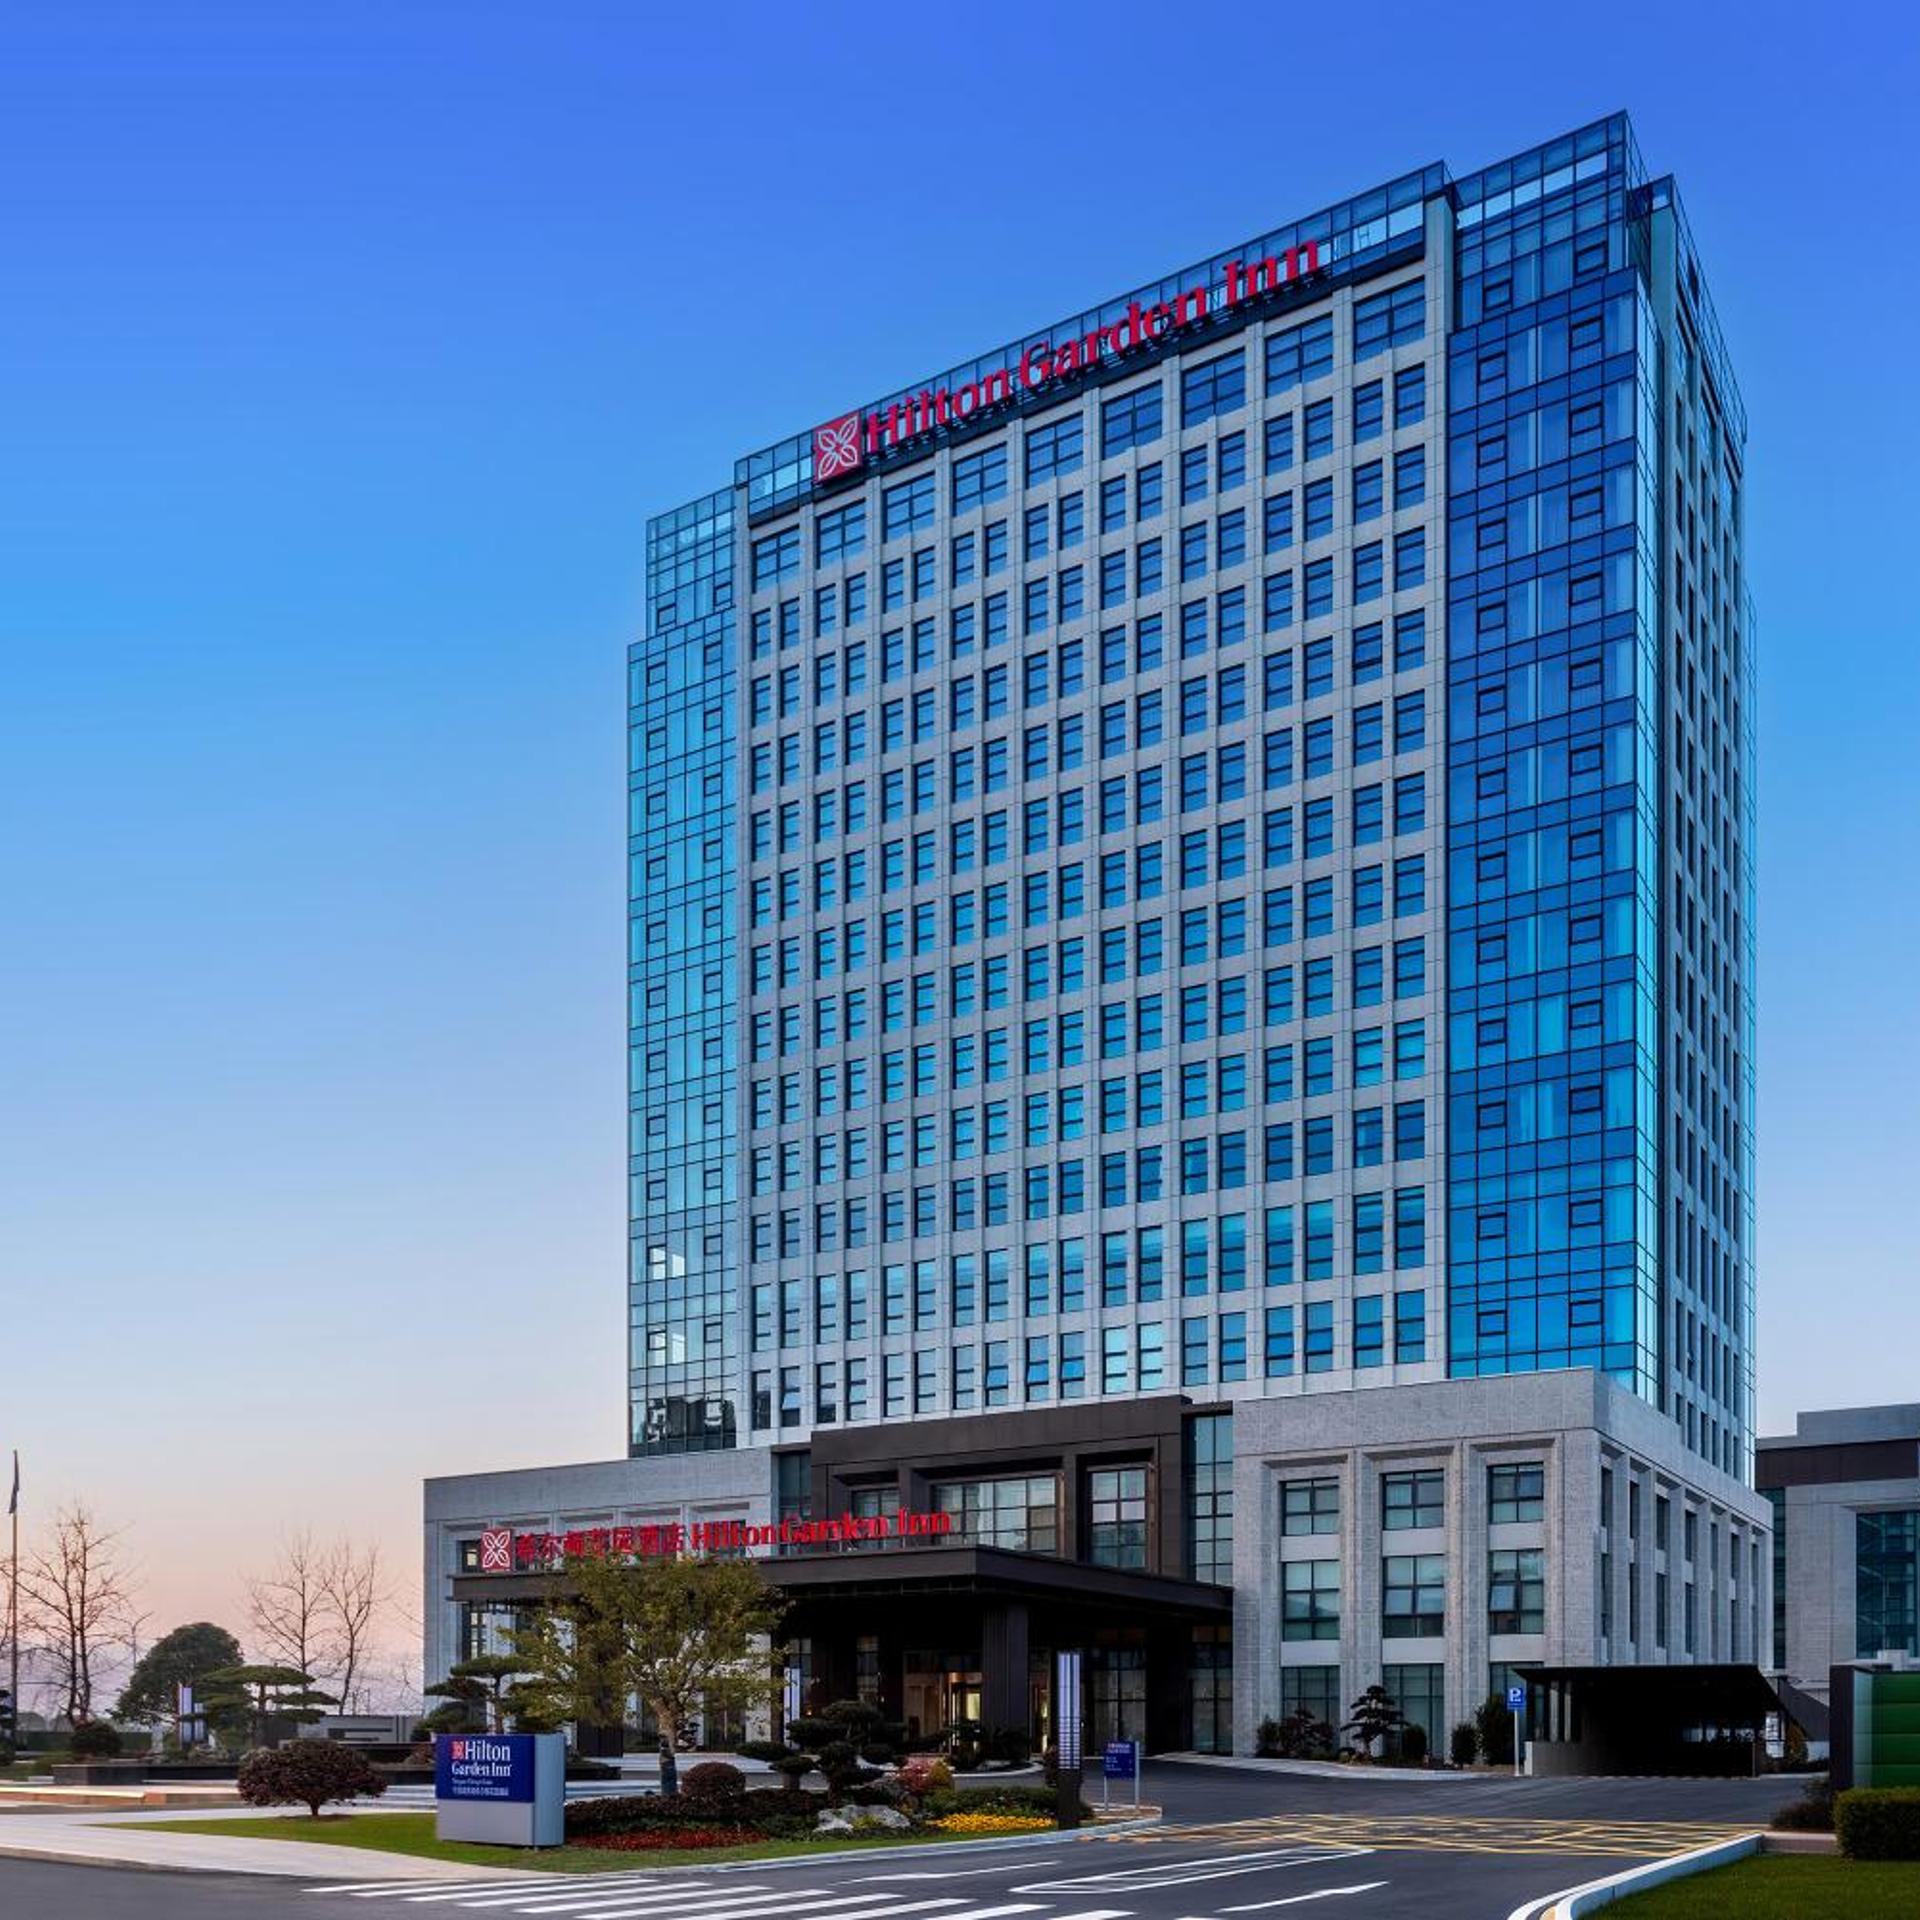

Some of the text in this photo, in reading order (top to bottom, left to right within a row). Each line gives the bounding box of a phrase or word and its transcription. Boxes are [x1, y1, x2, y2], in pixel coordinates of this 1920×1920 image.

[867, 240, 1319, 454] Hilton Garden Inn
[690, 1506, 950, 1549] Hilton Garden Inn
[464, 1739, 511, 1761] Hilton
[451, 1760, 511, 1777] Garden Inn
